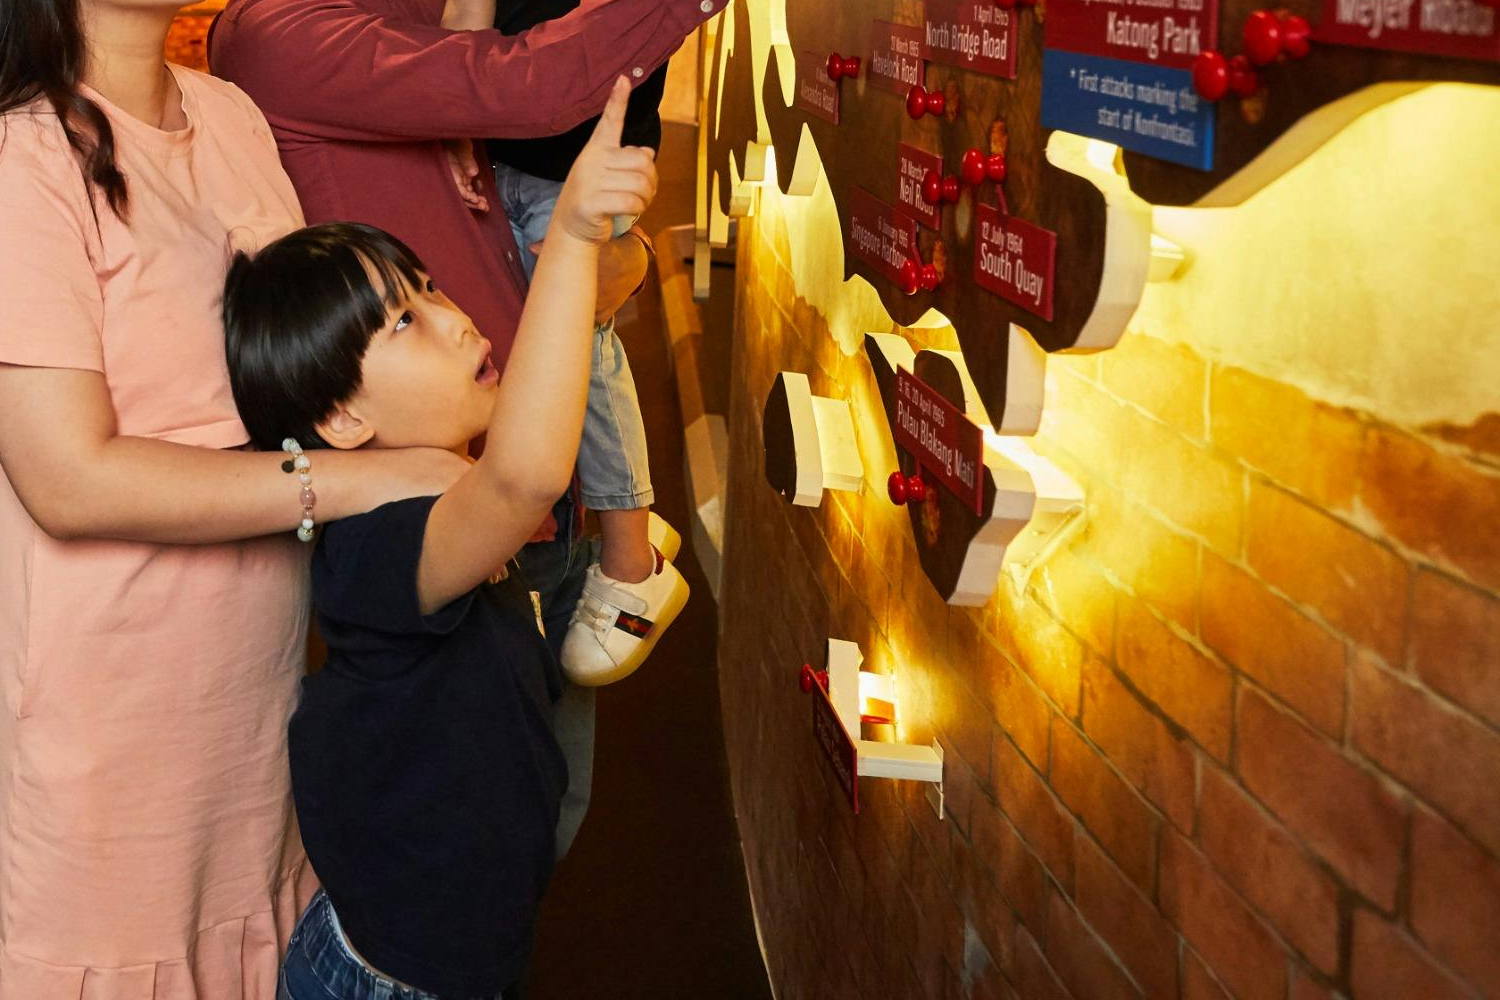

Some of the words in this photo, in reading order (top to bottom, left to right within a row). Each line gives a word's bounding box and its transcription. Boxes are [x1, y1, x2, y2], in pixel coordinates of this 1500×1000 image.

[978, 4, 993, 27] April
[925, 20, 949, 49] North
[951, 24, 980, 62] Bridge
[982, 28, 1008, 61] Road
[1106, 11, 1160, 60] Katong
[1163, 16, 1201, 55] Park
[872, 49, 900, 80] Havelock
[900, 57, 918, 86] Road
[822, 88, 834, 113] Road
[1078, 68, 1099, 93] First
[1100, 75, 1135, 101] attacks
[1137, 81, 1177, 115] marking
[1178, 86, 1199, 113] the
[1097, 106, 1121, 130] start
[1122, 109, 1134, 131] of
[908, 160, 922, 180] March
[900, 175, 914, 206] Neil
[852, 216, 880, 256] Singapore
[990, 225, 1005, 252] July
[1006, 232, 1023, 255] 1964
[980, 243, 1012, 283] South
[1015, 258, 1044, 306] Quay
[920, 393, 932, 416] April
[898, 400, 918, 439] Pulau
[920, 419, 953, 477] Blakang
[955, 448, 975, 489] Mati
